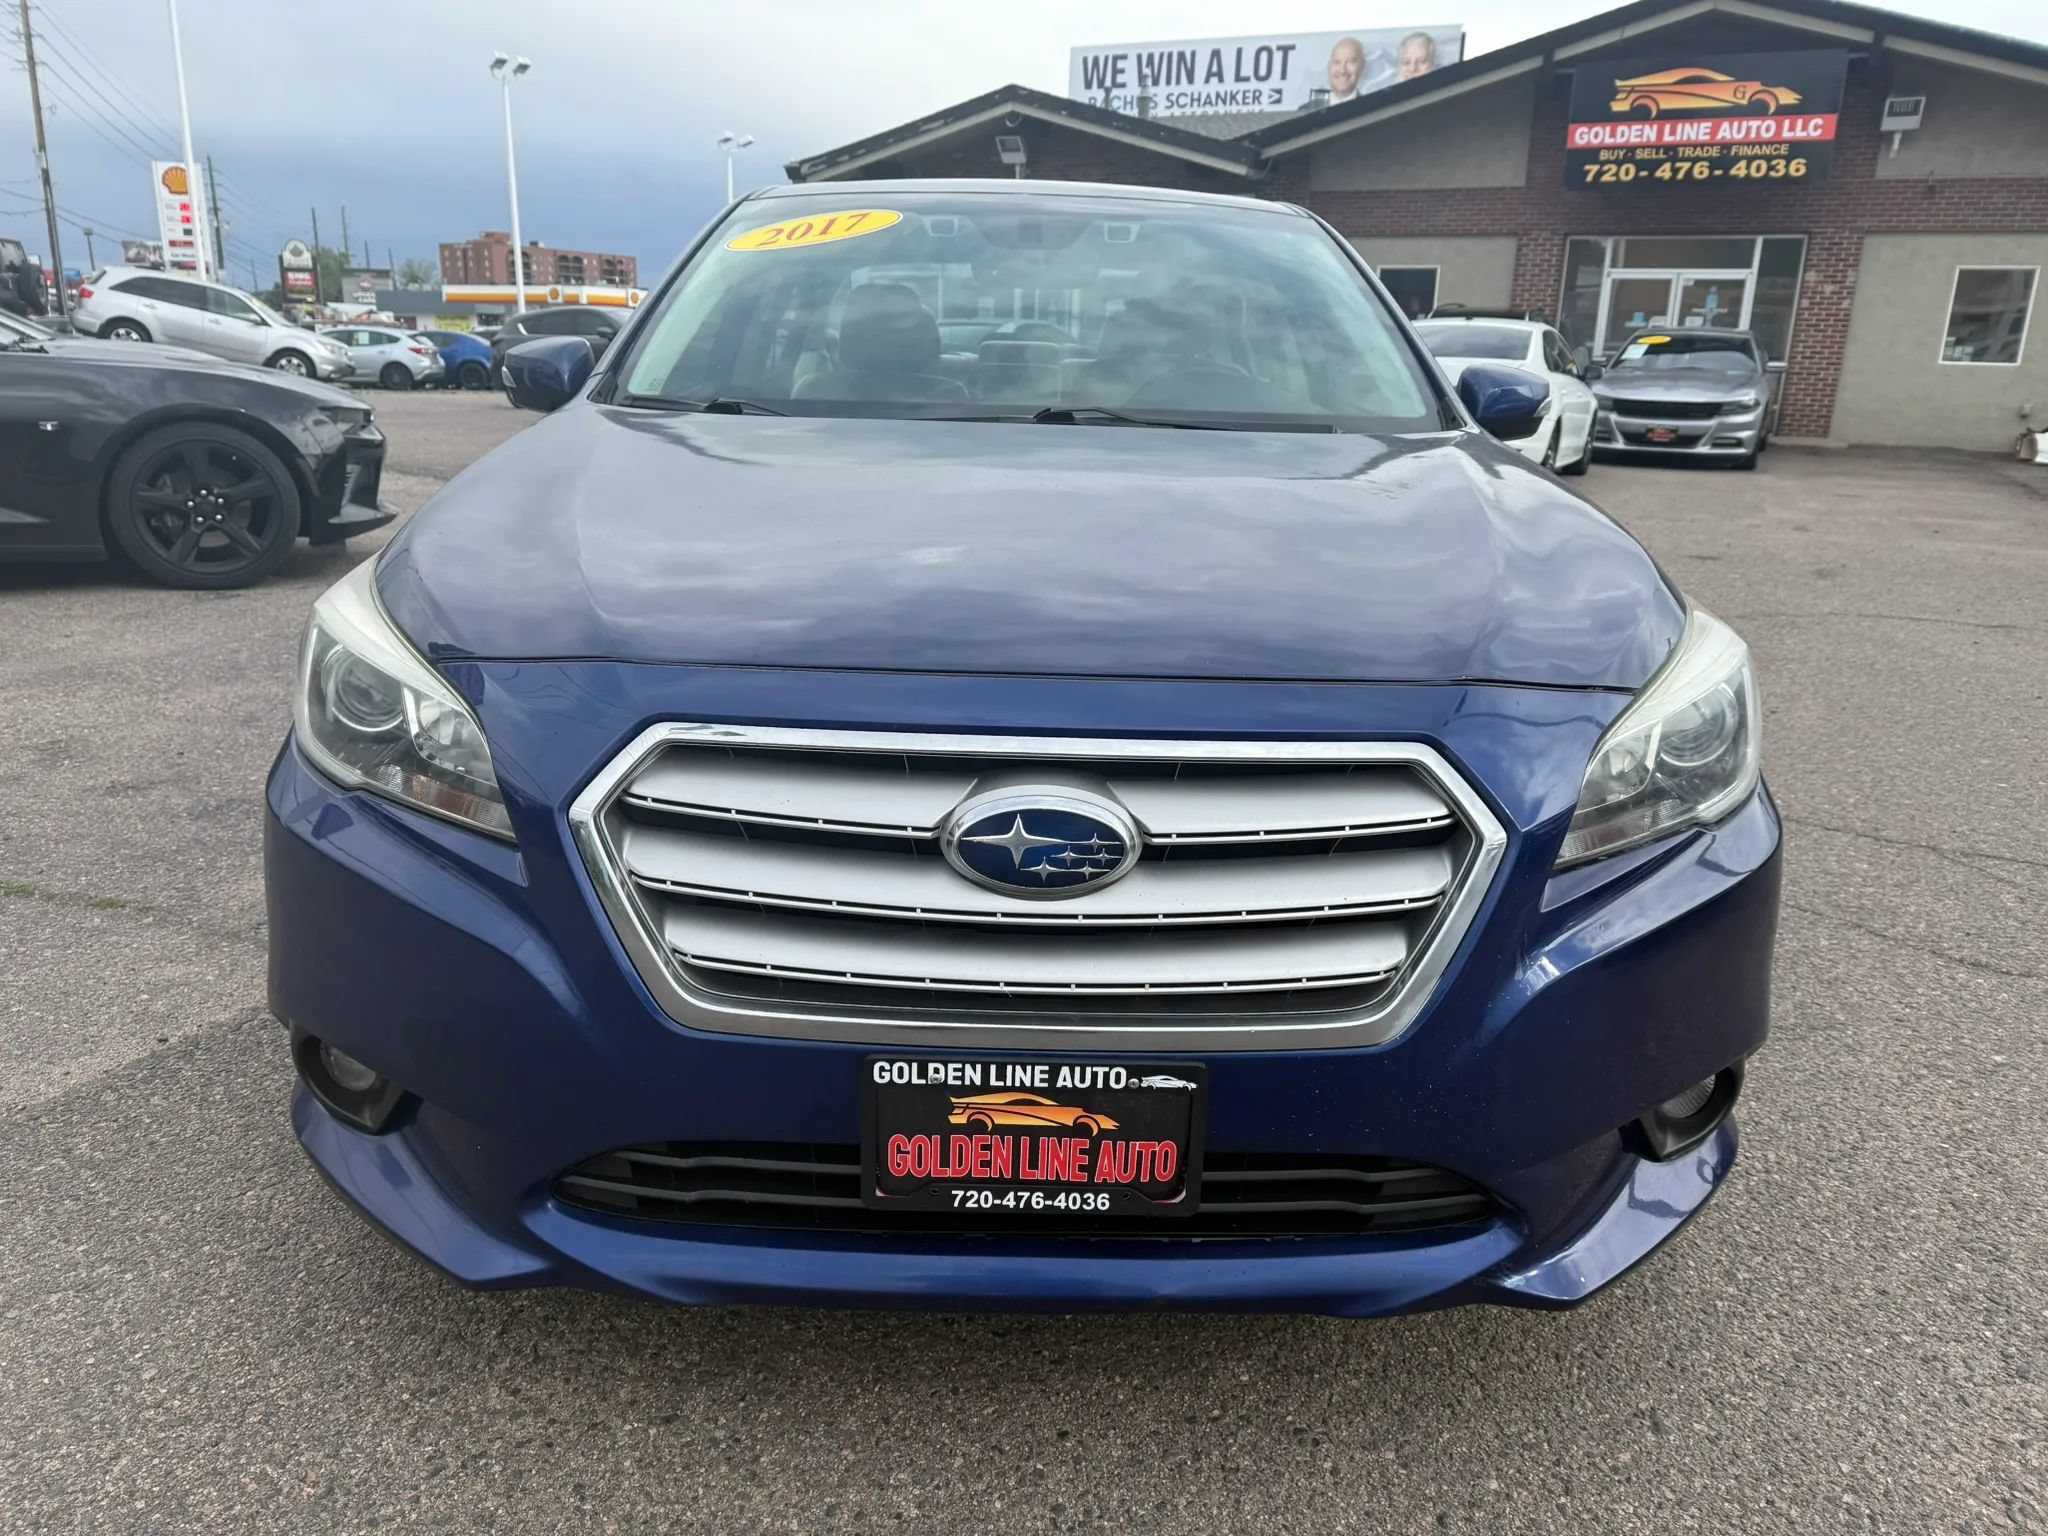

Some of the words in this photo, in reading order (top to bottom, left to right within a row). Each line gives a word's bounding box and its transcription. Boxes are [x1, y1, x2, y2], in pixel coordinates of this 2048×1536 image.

[1082, 54, 1128, 90] WE
[1136, 49, 1197, 87] WIN
[1204, 48, 1225, 84] A
[1234, 44, 1296, 82] LOT
[1165, 89, 1263, 109] SCHANKER
[1574, 124, 1657, 145] GOLDEN
[1663, 122, 1712, 142] LINE
[1716, 119, 1776, 140] AUTO
[1782, 118, 1824, 138] LLC
[1599, 149, 1625, 161] BUY
[1635, 148, 1667, 159] SELL
[1678, 146, 1721, 158] TRADE
[1731, 144, 1789, 156] FINANCE
[755, 212, 872, 247] 2017
[872, 1061, 981, 1086] GOLDEN
[989, 1063, 1049, 1088] LINE
[1056, 1066, 1128, 1089] AUTO
[887, 1133, 1012, 1179] GOLDEN
[1019, 1136, 1090, 1183] LINE
[1094, 1140, 1177, 1184] AUTO
[951, 1190, 1110, 1211] 720-476-4036
